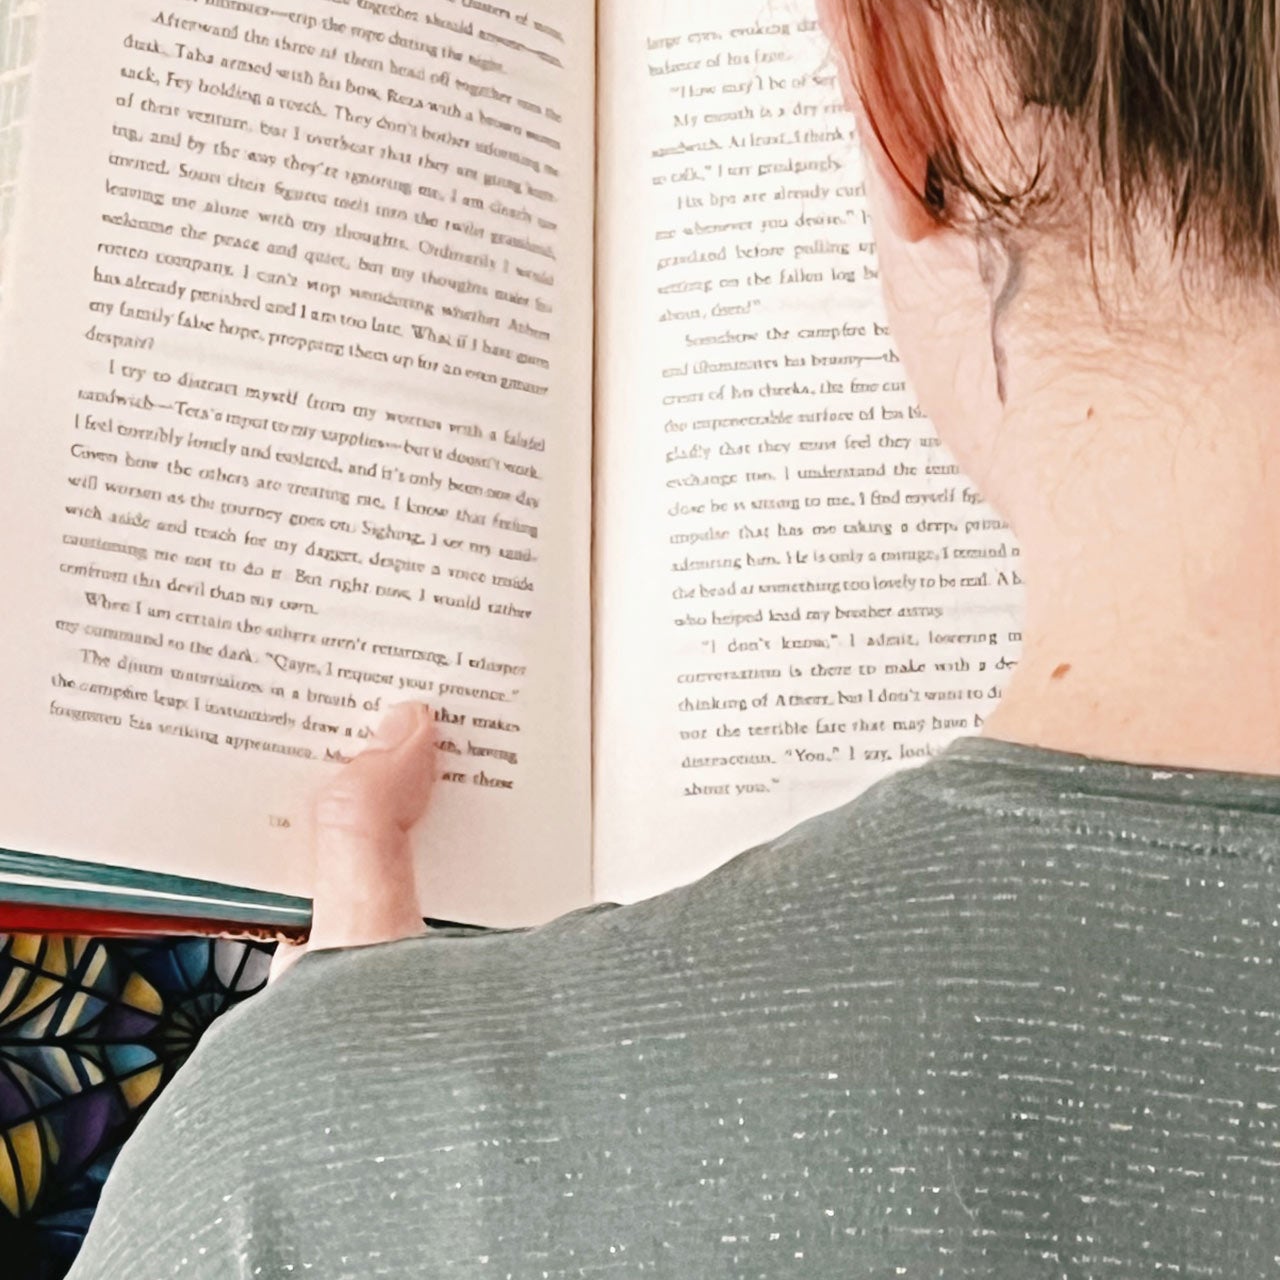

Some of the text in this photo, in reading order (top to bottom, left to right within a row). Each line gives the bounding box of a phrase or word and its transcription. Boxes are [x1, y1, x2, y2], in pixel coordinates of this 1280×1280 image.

[768, 76, 786, 90] be
[335, 105, 372, 128] They
[187, 135, 206, 154] by
[743, 184, 830, 203] are already
[266, 244, 297, 258] and
[779, 267, 856, 284] fallen log
[123, 275, 187, 301] already
[758, 439, 791, 453] they
[844, 434, 871, 450] feel
[878, 433, 912, 450] they
[348, 463, 377, 478] and
[797, 462, 886, 479] understand
[893, 462, 919, 476] the
[804, 497, 821, 507] to
[777, 522, 804, 537] has
[843, 520, 894, 536] taking
[920, 577, 937, 589] to
[362, 697, 381, 711] of
[751, 693, 769, 709] of
[966, 689, 984, 701] to
[716, 723, 741, 737] the
[747, 720, 809, 736] terrible
[441, 772, 466, 783] are
